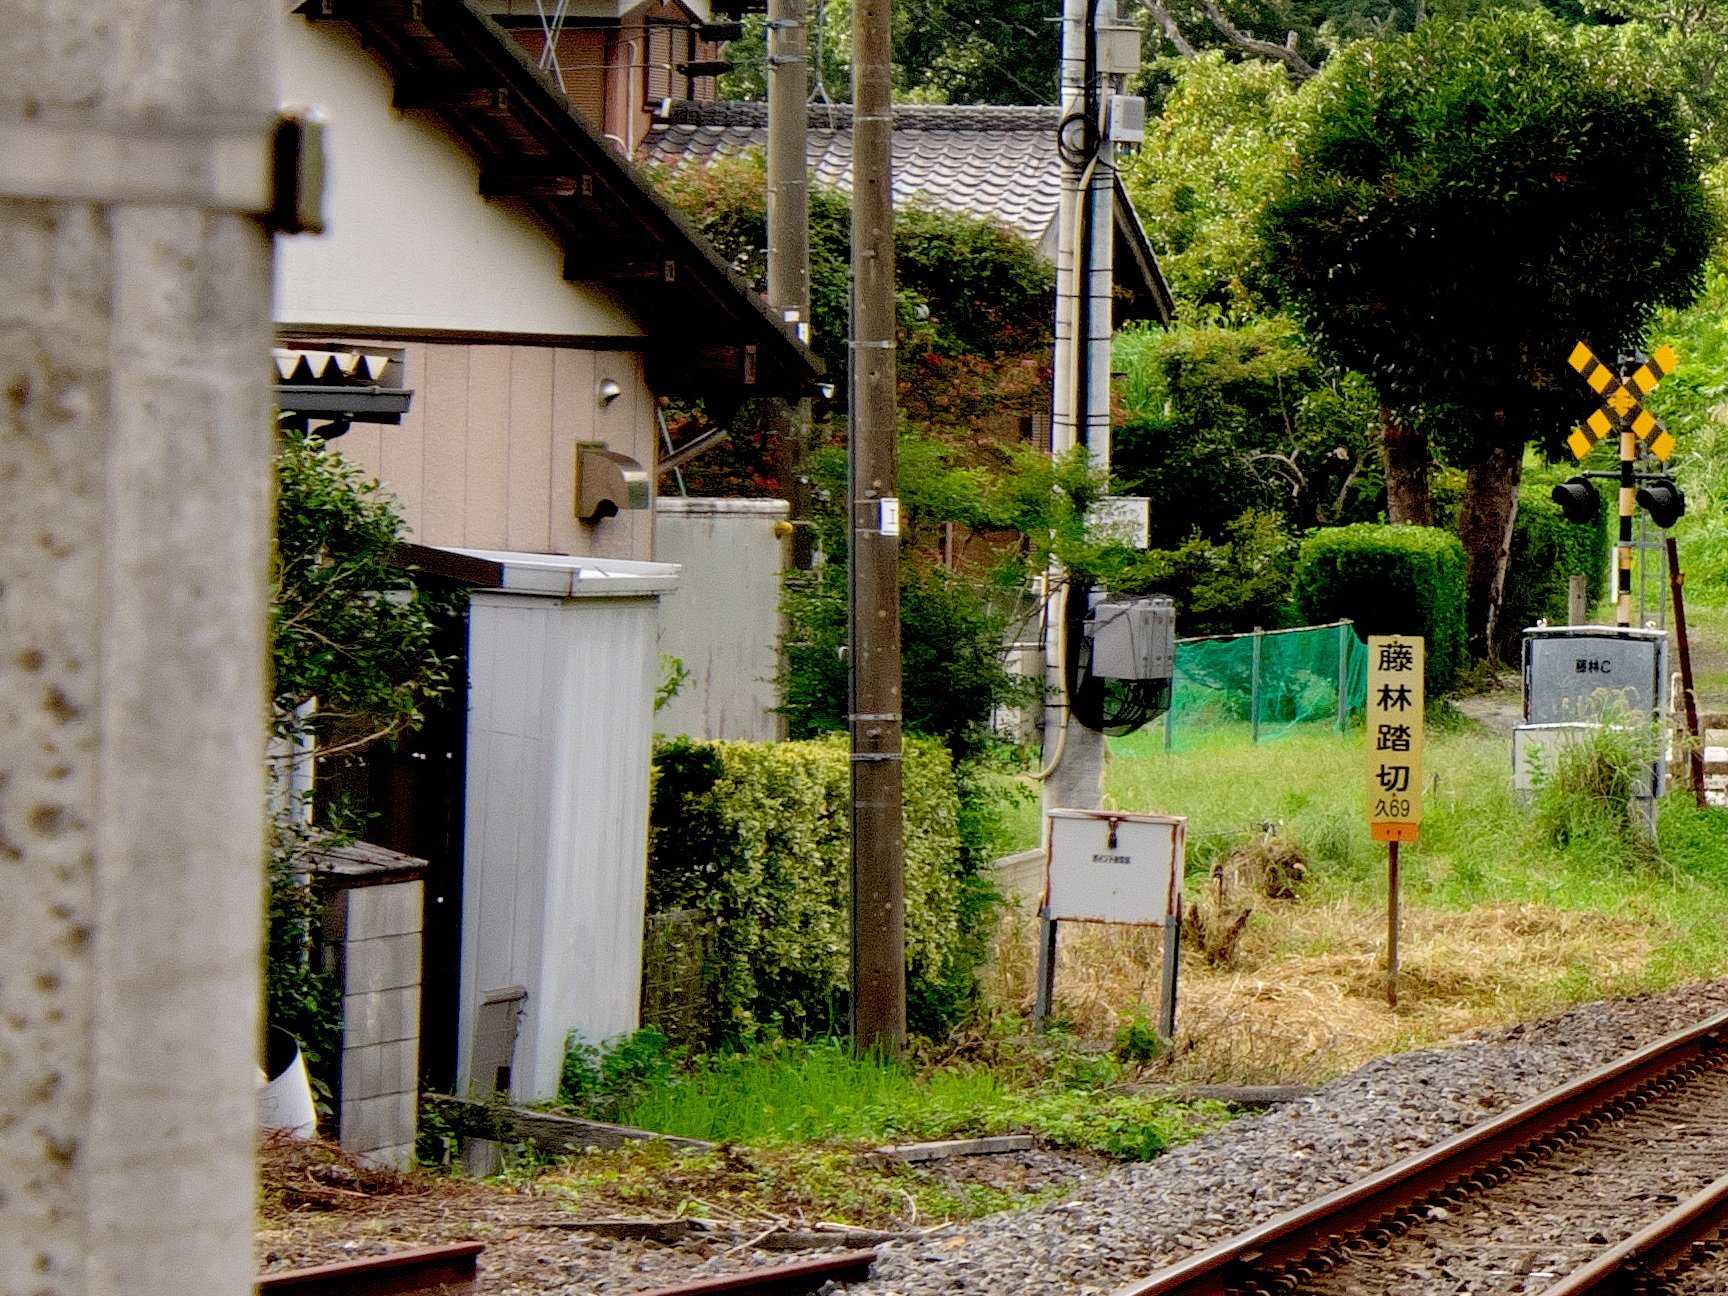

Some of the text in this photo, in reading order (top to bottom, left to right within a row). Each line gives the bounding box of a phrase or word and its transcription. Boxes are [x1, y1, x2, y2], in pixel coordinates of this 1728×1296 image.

[1376, 643, 1413, 792] 藤林踏切
[1375, 798, 1410, 817] 久69
